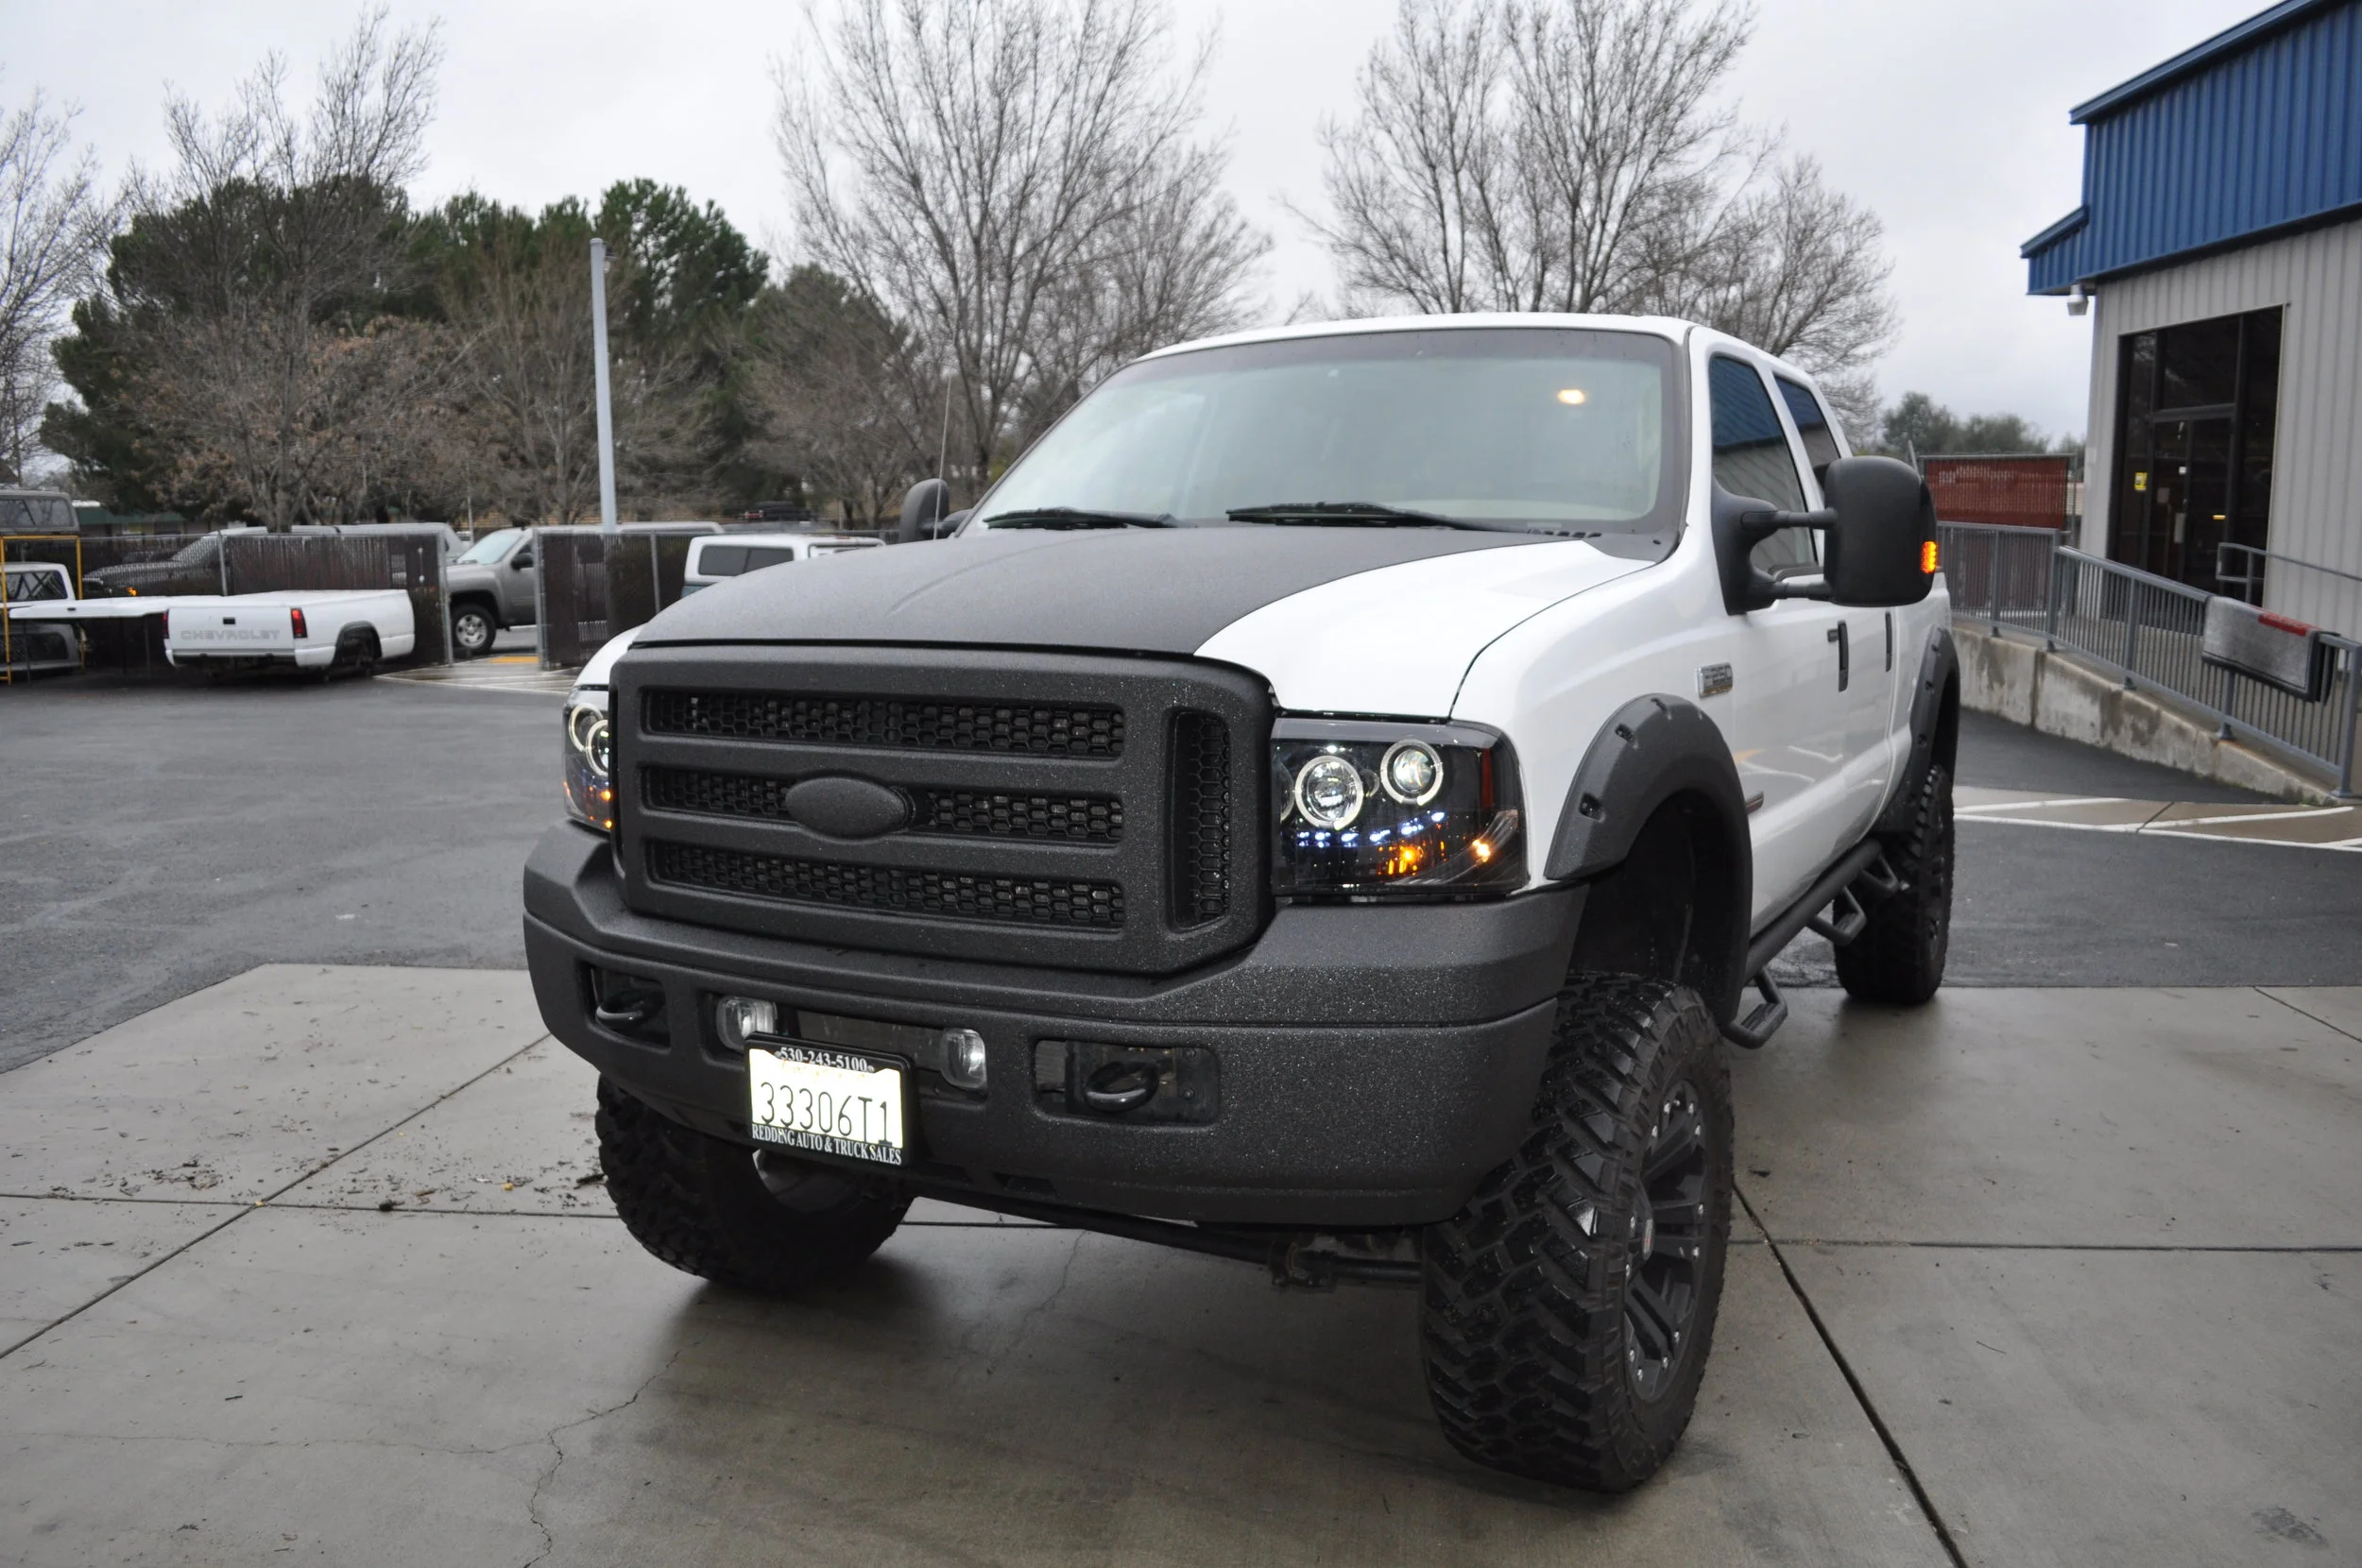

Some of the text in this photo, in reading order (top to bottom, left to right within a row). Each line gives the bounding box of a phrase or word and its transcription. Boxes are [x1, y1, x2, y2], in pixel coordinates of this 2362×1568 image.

[180, 629, 281, 640] CHEVROLET
[780, 1047, 867, 1072] 530-243-5100
[761, 1082, 893, 1146] 33306T1
[752, 1124, 901, 1166] REDDING AUTO & TRUCK SALES
